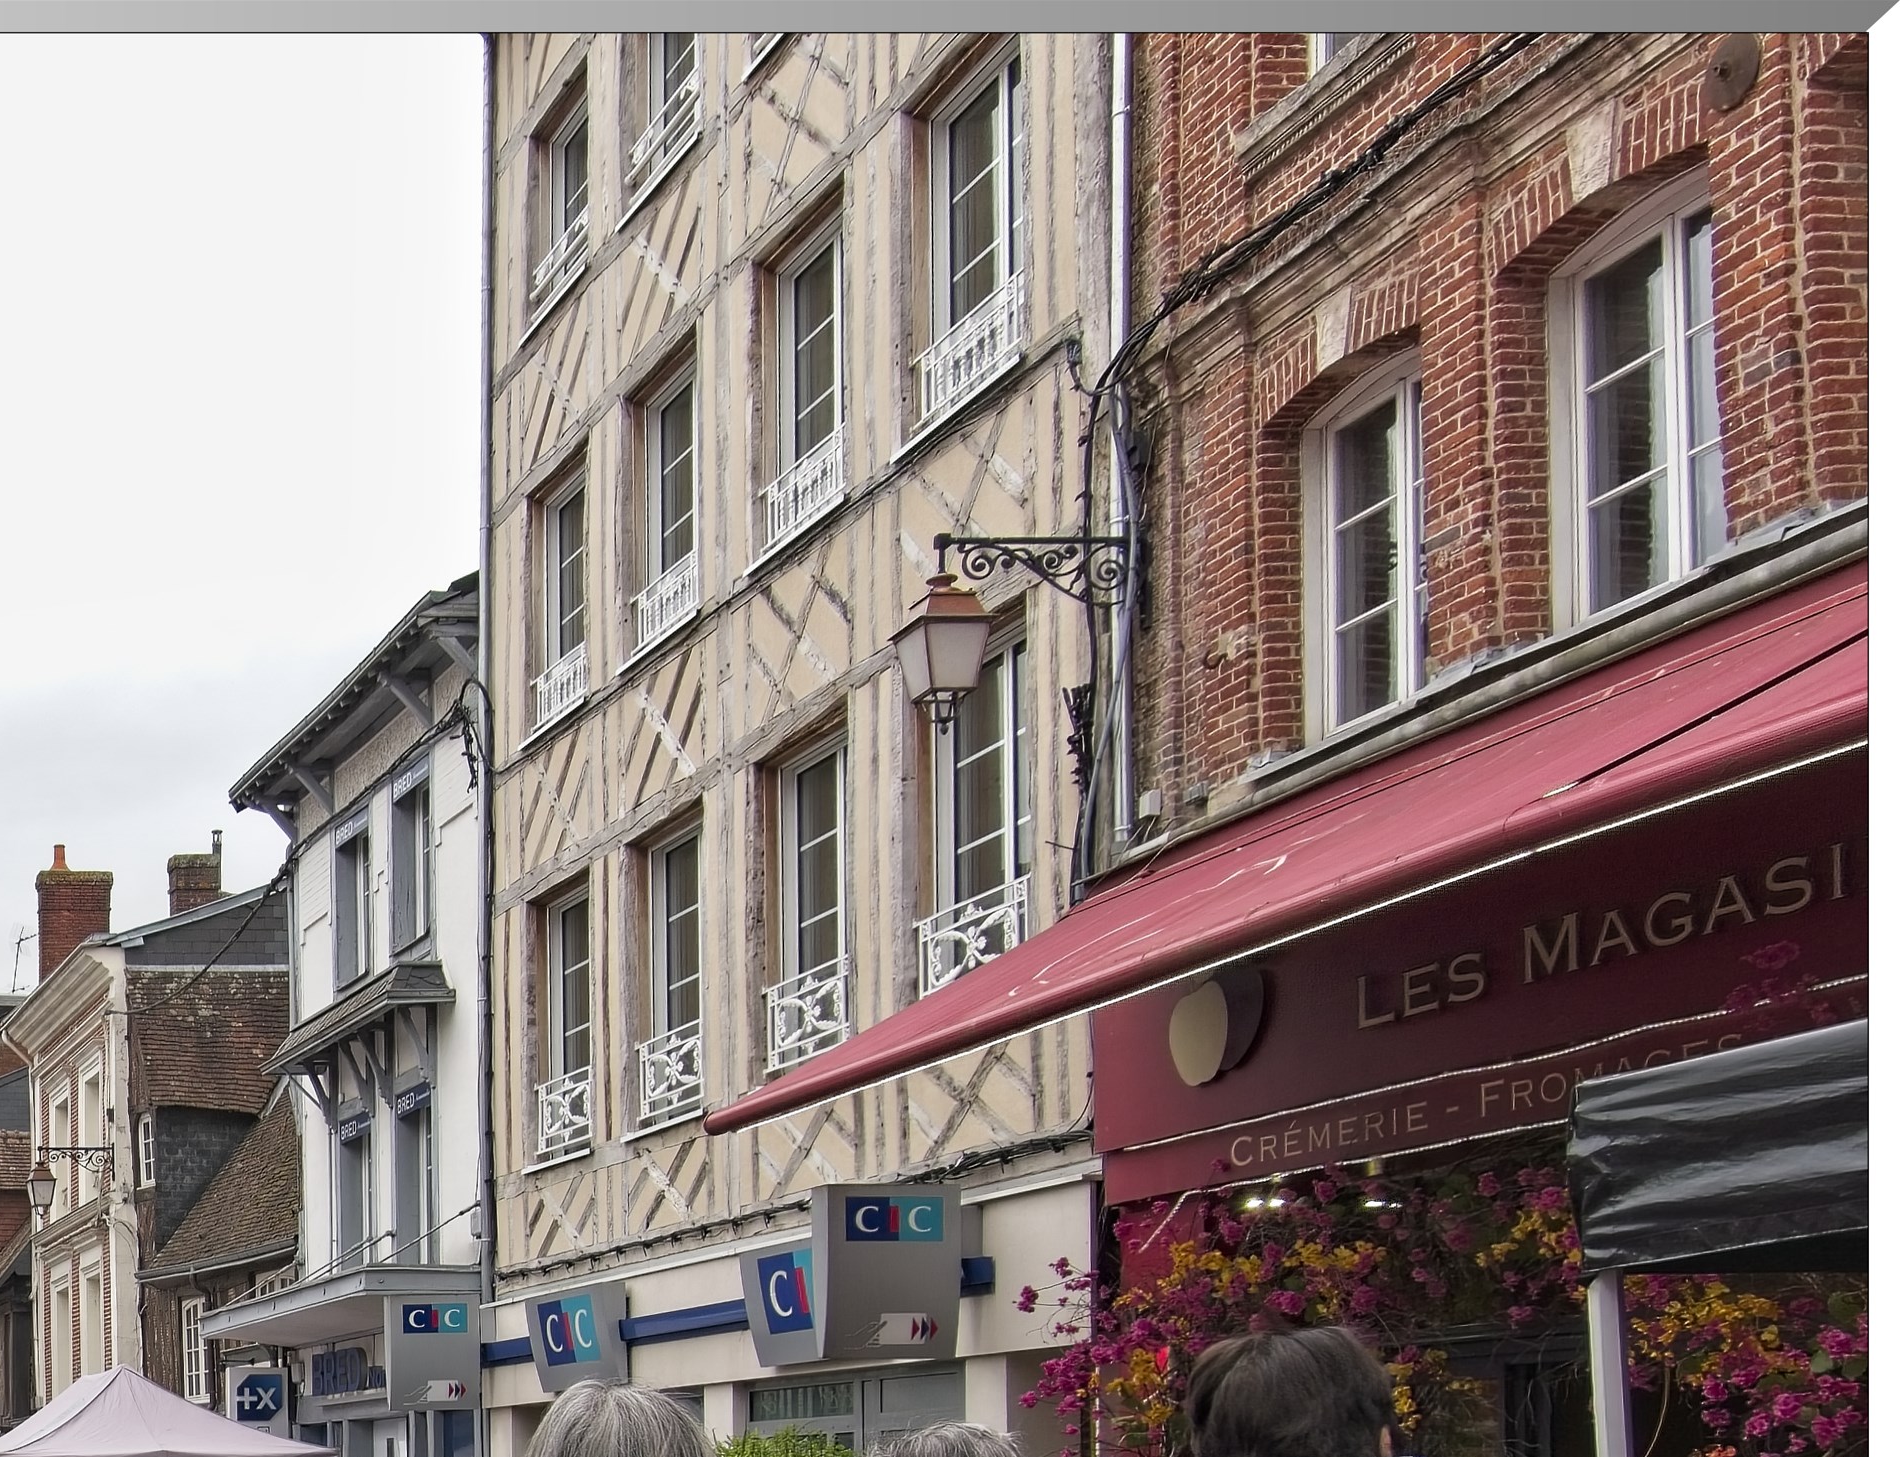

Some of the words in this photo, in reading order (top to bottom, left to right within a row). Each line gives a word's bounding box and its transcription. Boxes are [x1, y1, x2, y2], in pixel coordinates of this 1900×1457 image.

[393, 772, 412, 799] BRED
[336, 821, 353, 845] BRED
[1356, 952, 1486, 1030] LES
[1521, 843, 1846, 984] MAGASI
[397, 1092, 415, 1115] BRED
[340, 1120, 357, 1141] BRED
[1231, 1101, 1428, 1167] CRÉMERIE
[854, 1205, 933, 1234] CIC
[769, 1266, 812, 1318] CI
[407, 1308, 461, 1329] CIC
[546, 1308, 593, 1353] CIC
[311, 1348, 368, 1397] BRED
